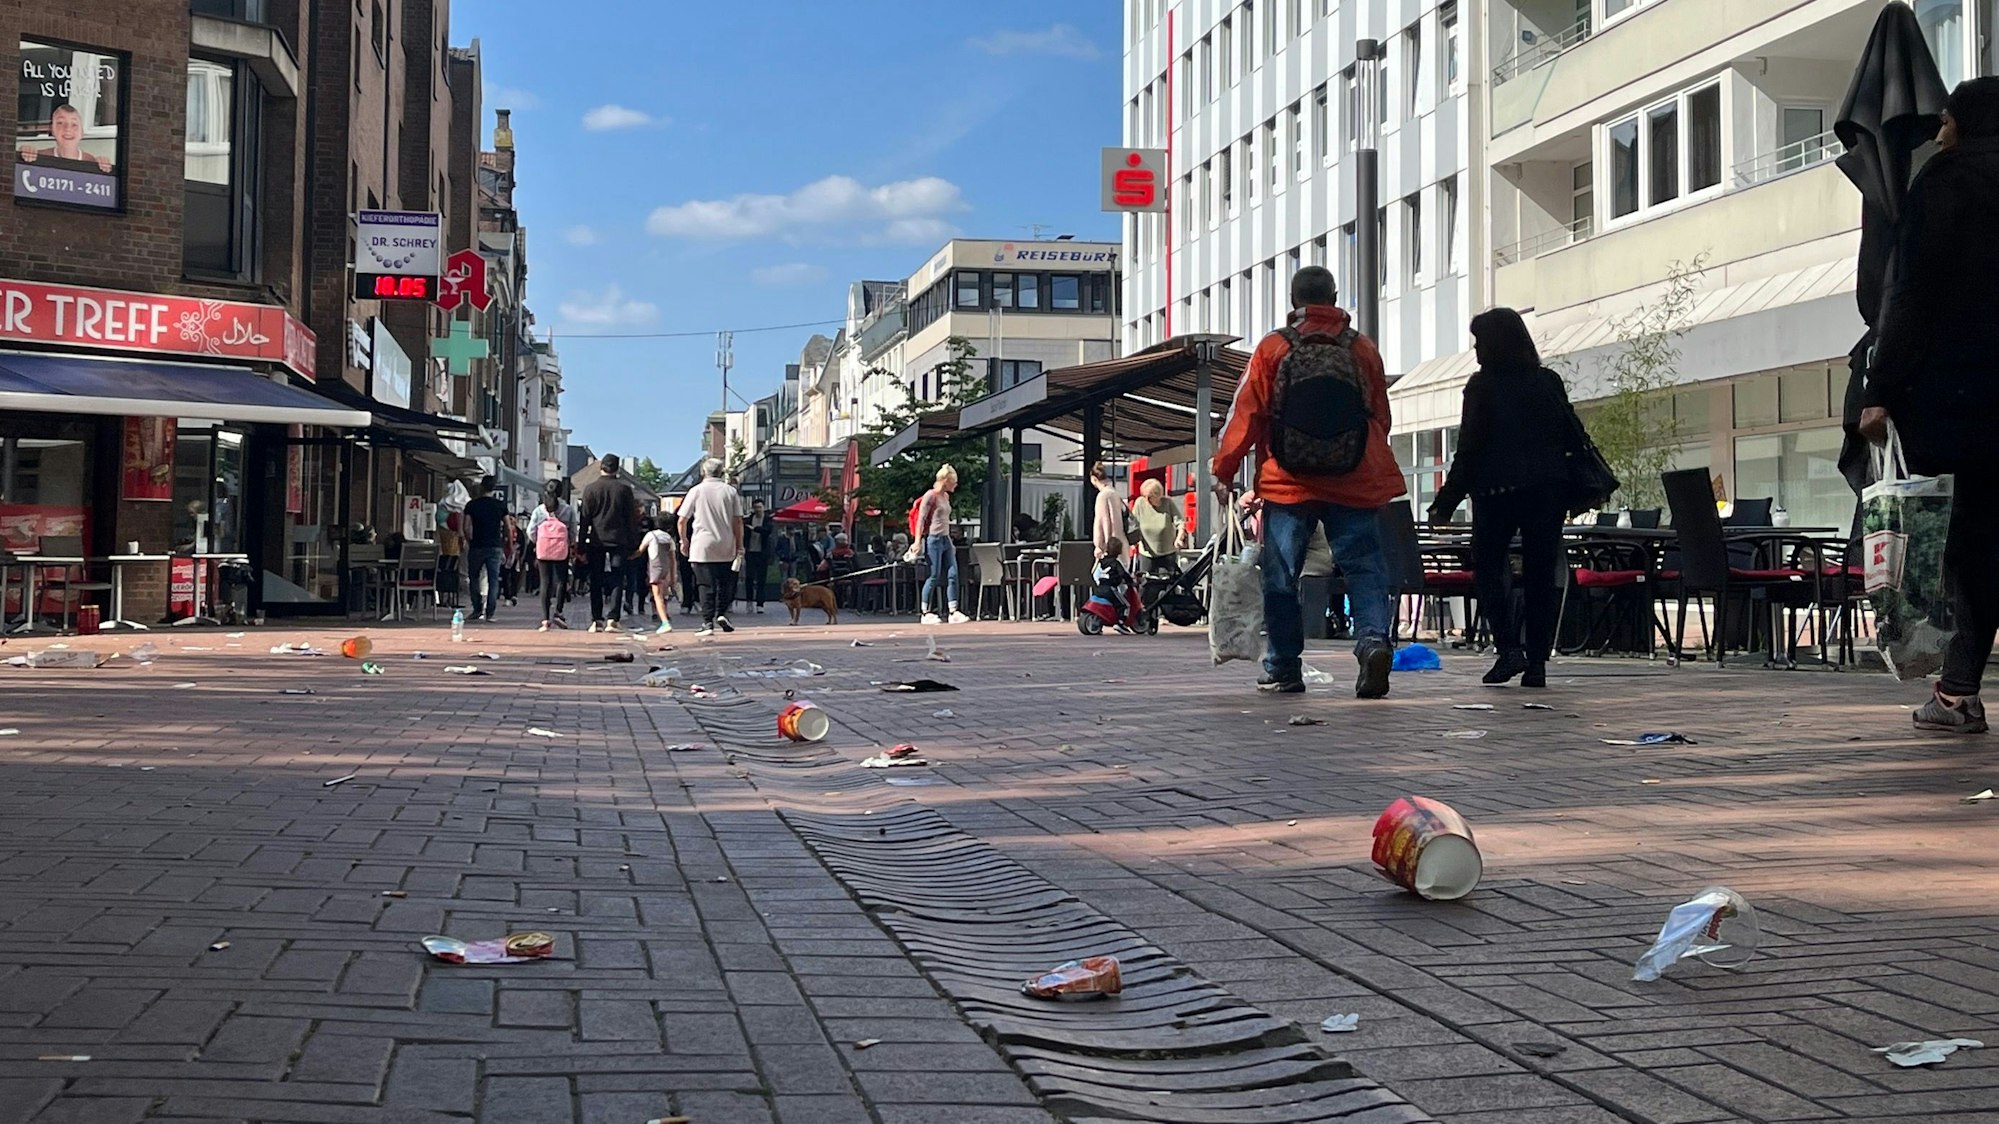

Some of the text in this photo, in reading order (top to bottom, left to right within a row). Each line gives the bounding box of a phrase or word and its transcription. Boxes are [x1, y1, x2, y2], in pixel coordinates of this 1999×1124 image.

[23, 59, 45, 79] ALL
[48, 63, 72, 79] YOU
[40, 82, 55, 98] IS
[38, 176, 75, 192] 02171
[85, 182, 111, 197] 2411
[372, 236, 437, 248] DR. SCHREY
[46, 294, 169, 344] TREFF
[222, 316, 270, 346] حلال
